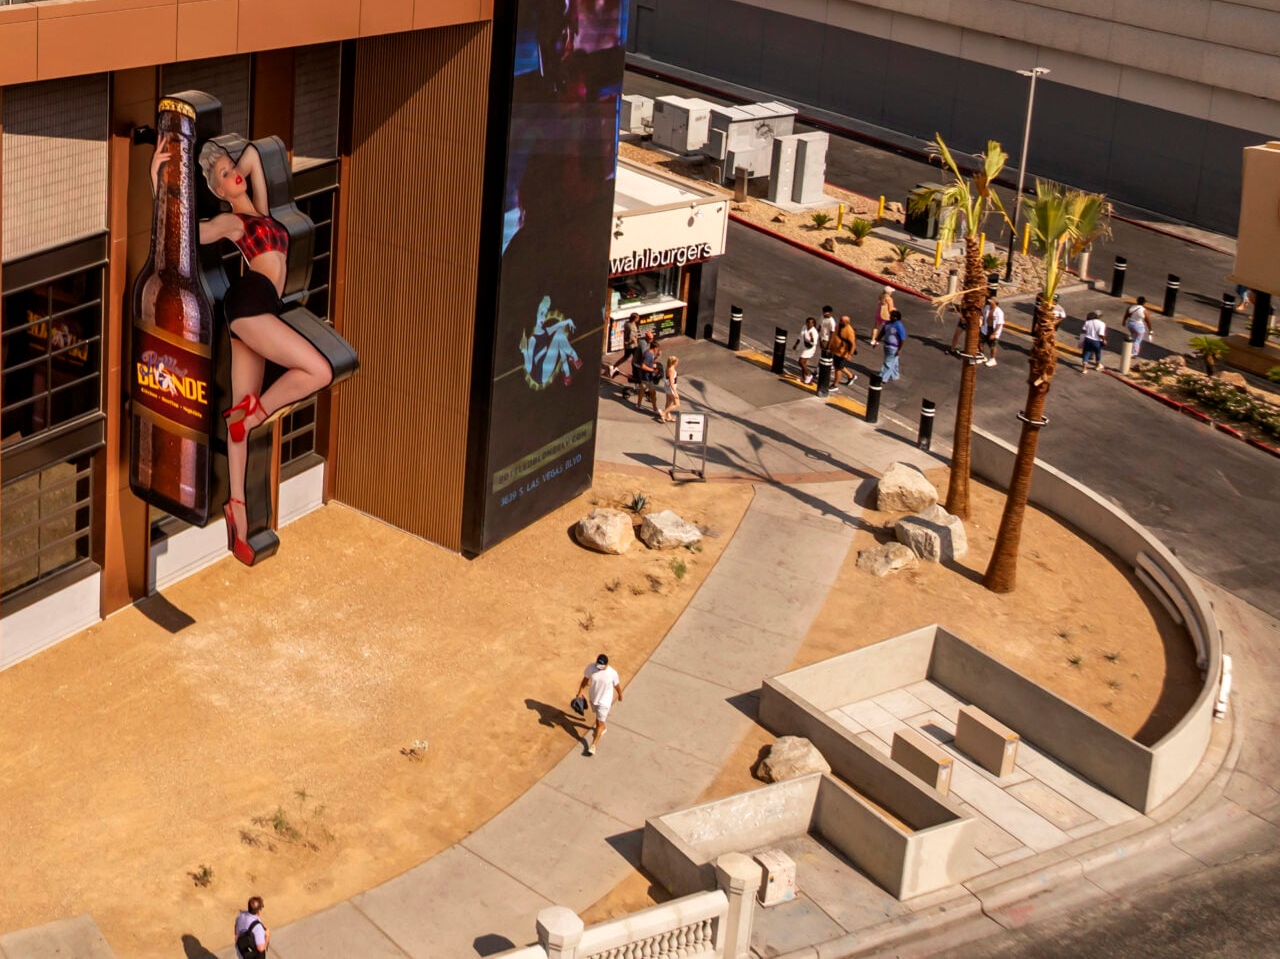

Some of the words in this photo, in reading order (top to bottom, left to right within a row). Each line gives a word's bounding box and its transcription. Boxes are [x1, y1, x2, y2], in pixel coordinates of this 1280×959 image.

[610, 242, 712, 273] wahlburgers
[137, 362, 208, 405] BLONDE
[526, 477, 540, 492] LAS
[542, 465, 564, 483] VEGAS
[565, 453, 582, 470] BLVD
